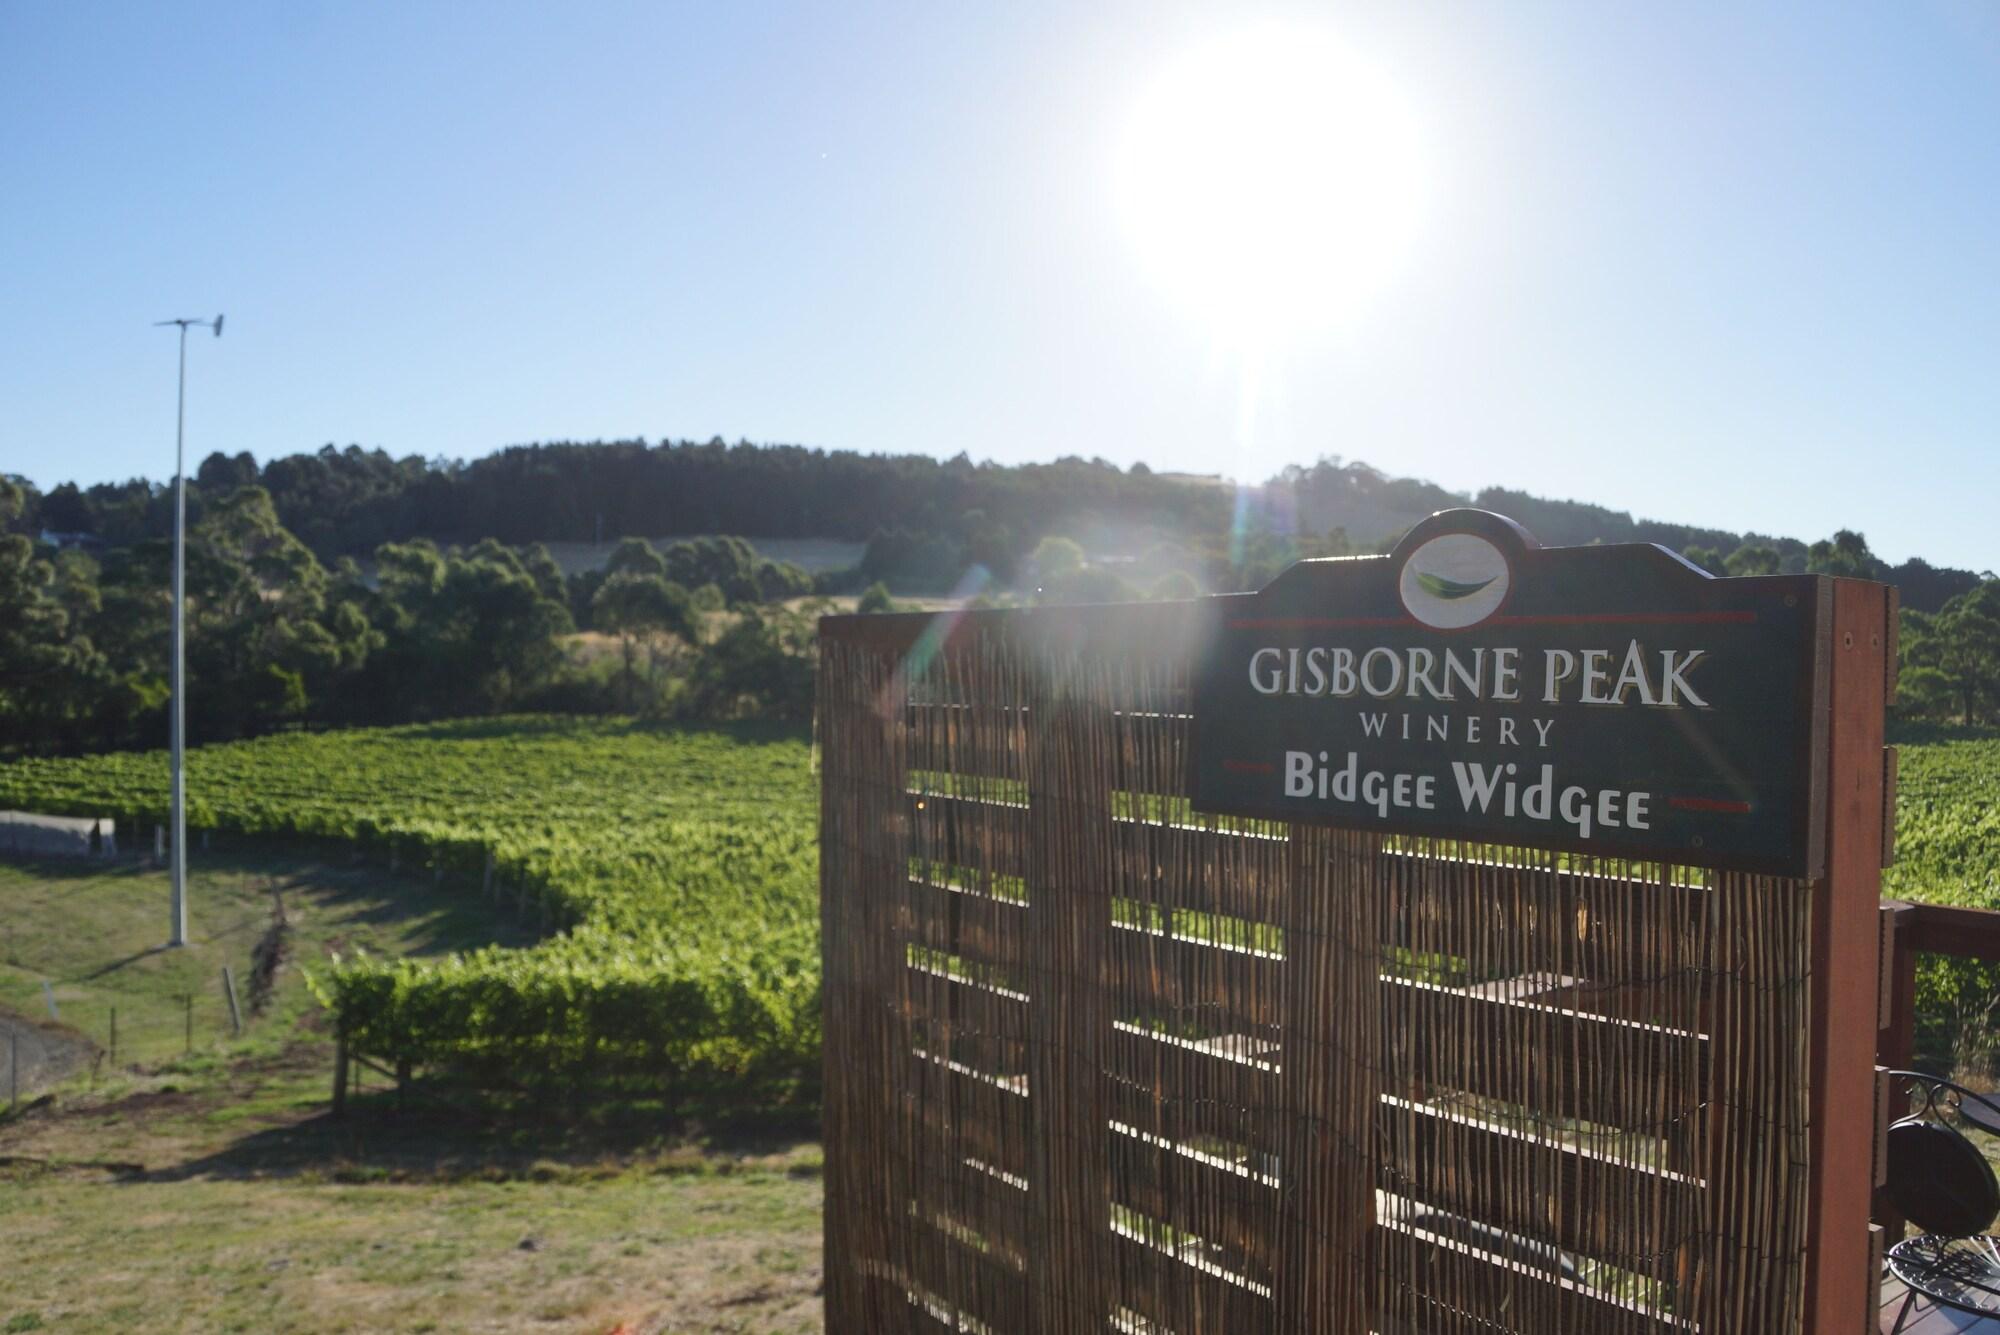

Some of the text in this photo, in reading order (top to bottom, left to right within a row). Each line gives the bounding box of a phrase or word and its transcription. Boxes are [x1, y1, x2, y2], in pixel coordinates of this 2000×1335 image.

[1248, 638, 1709, 708] GISBORNE PEAK
[1358, 712, 1555, 748] WINERY
